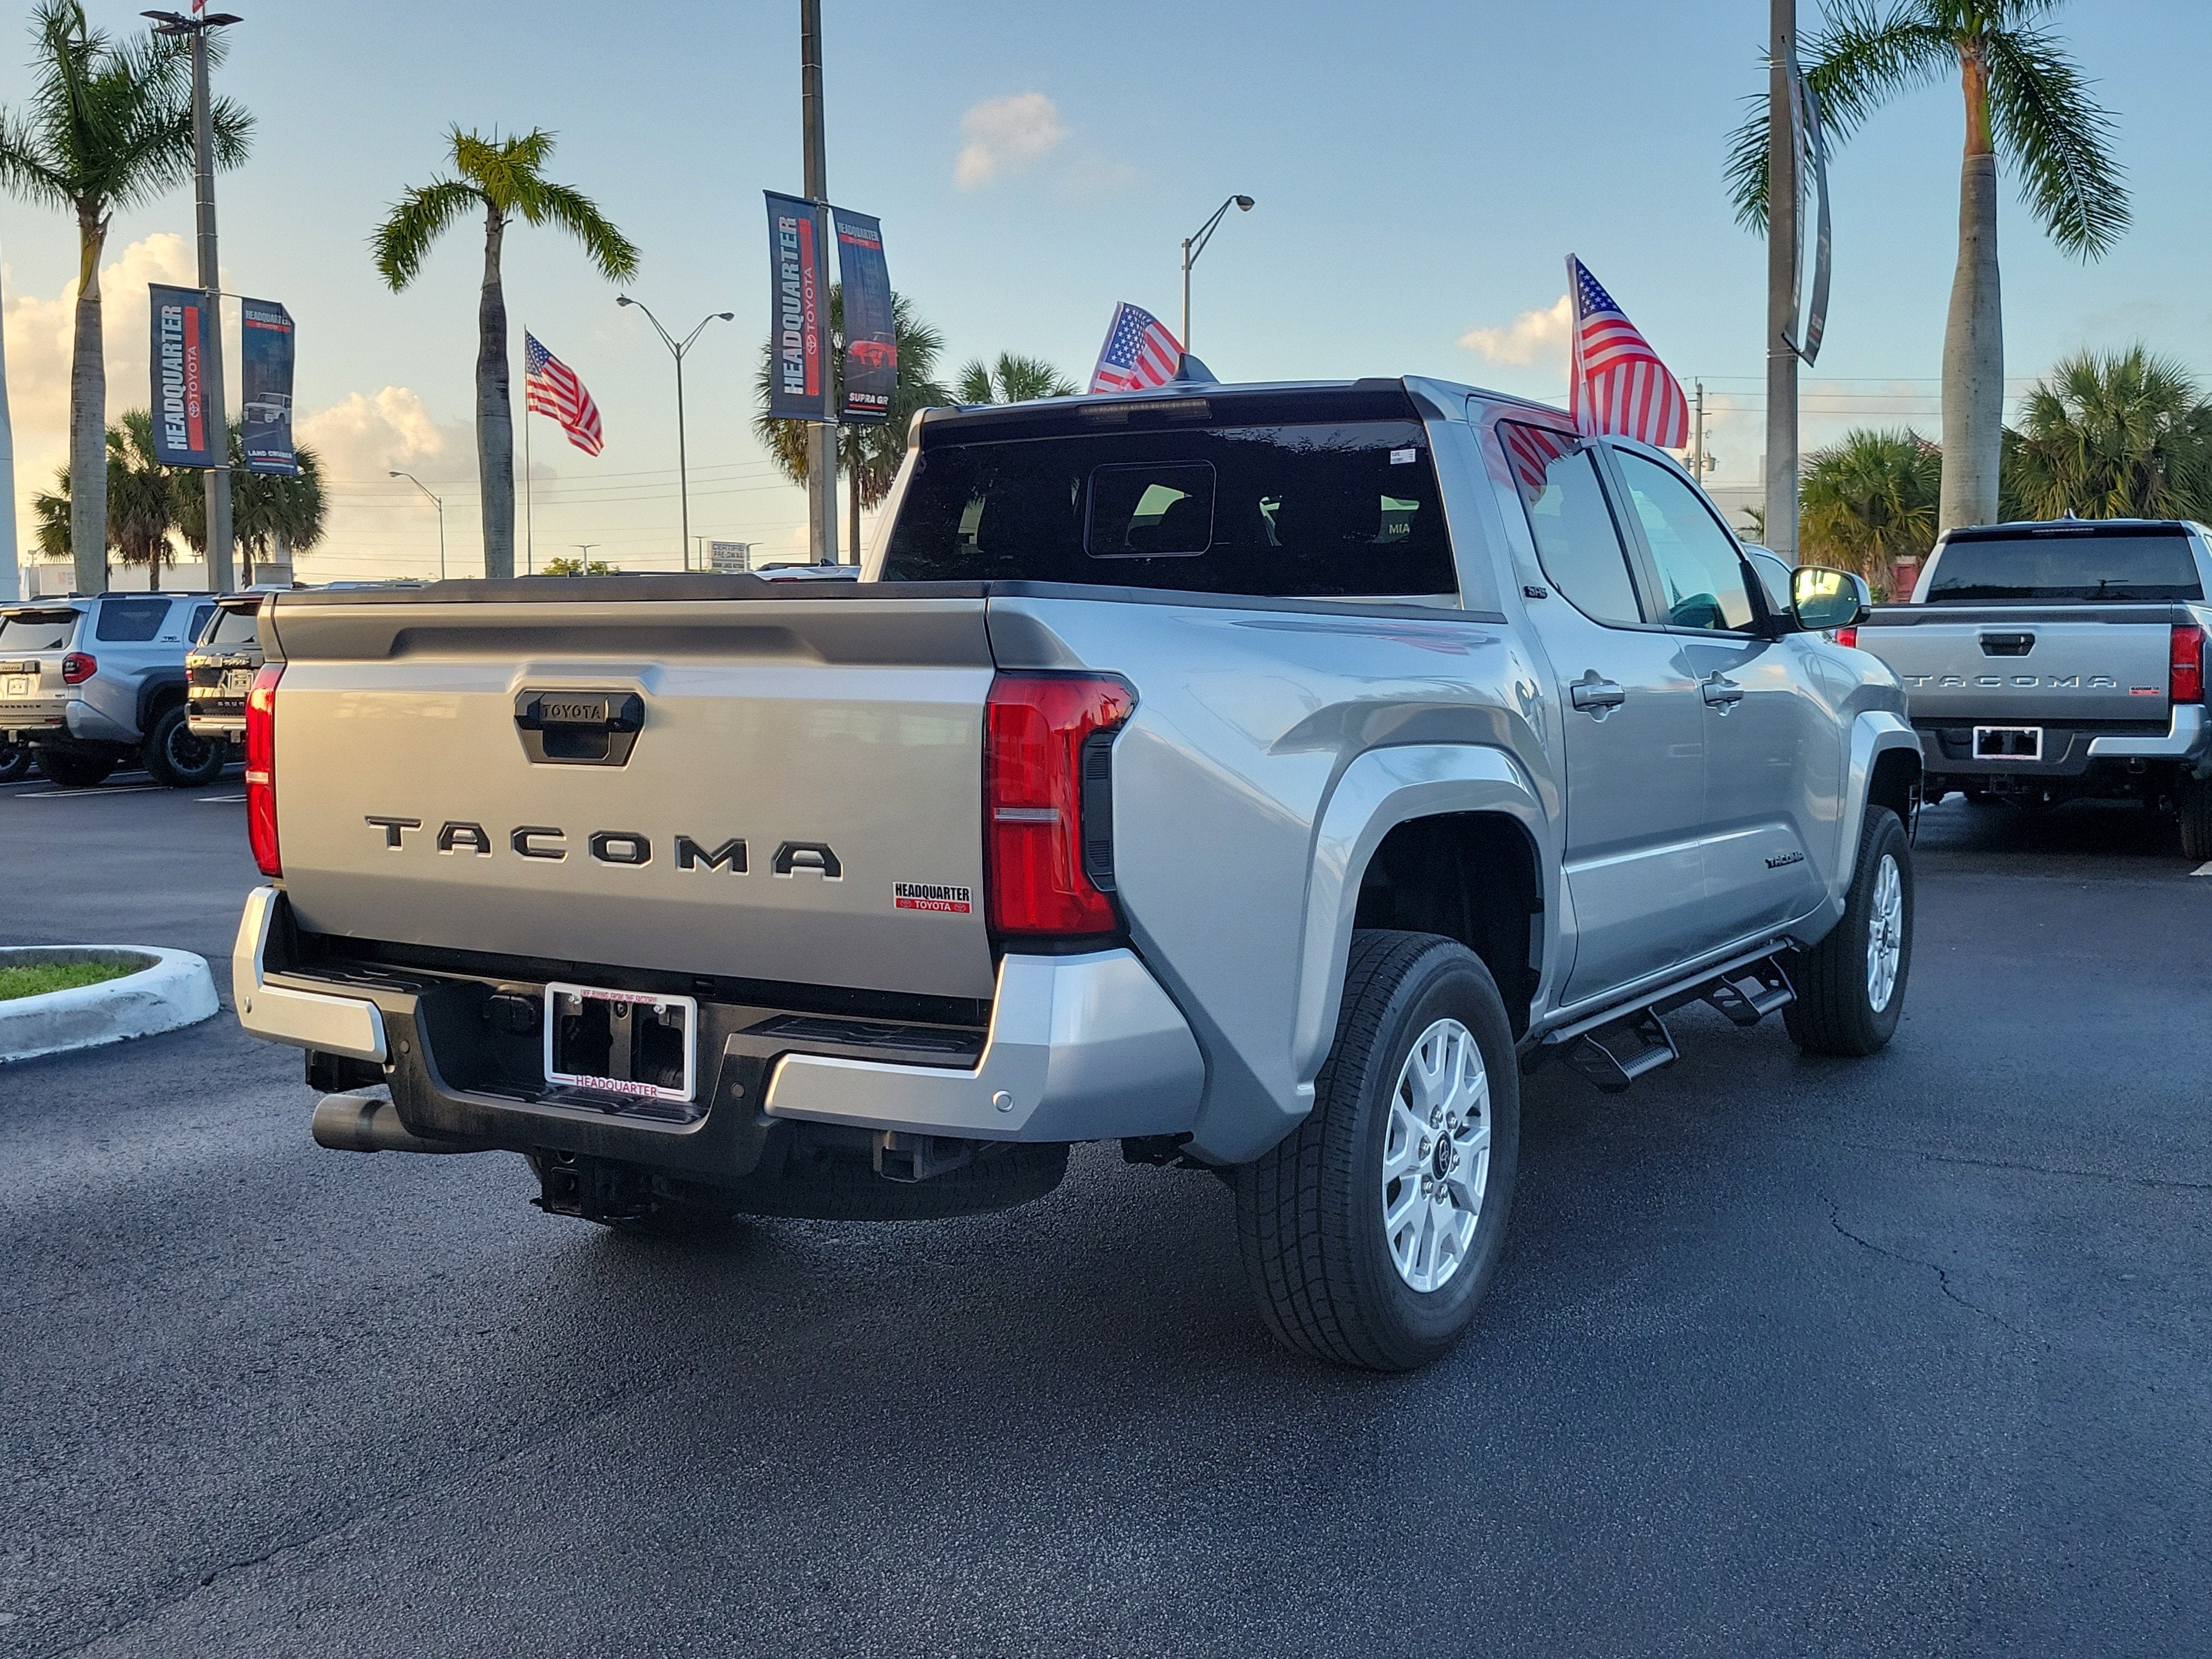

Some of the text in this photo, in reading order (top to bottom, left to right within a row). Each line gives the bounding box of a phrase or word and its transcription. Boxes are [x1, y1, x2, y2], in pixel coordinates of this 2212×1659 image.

[778, 216, 804, 396] HEADQUARTER
[804, 267, 817, 332] TOYOTA
[161, 305, 188, 450] HEADQUARTER
[188, 346, 199, 399] TOYOTA
[849, 392, 889, 405] SUPRA GR
[1389, 523, 1410, 534] MIA
[1903, 675, 2117, 688] TACOMA
[543, 704, 601, 719] TOYOTA
[364, 815, 843, 881] TACOMA
[895, 883, 969, 901] HEADQUARTER
[915, 900, 951, 911] TOYOTA
[576, 1076, 657, 1096] HEADQUARTER
